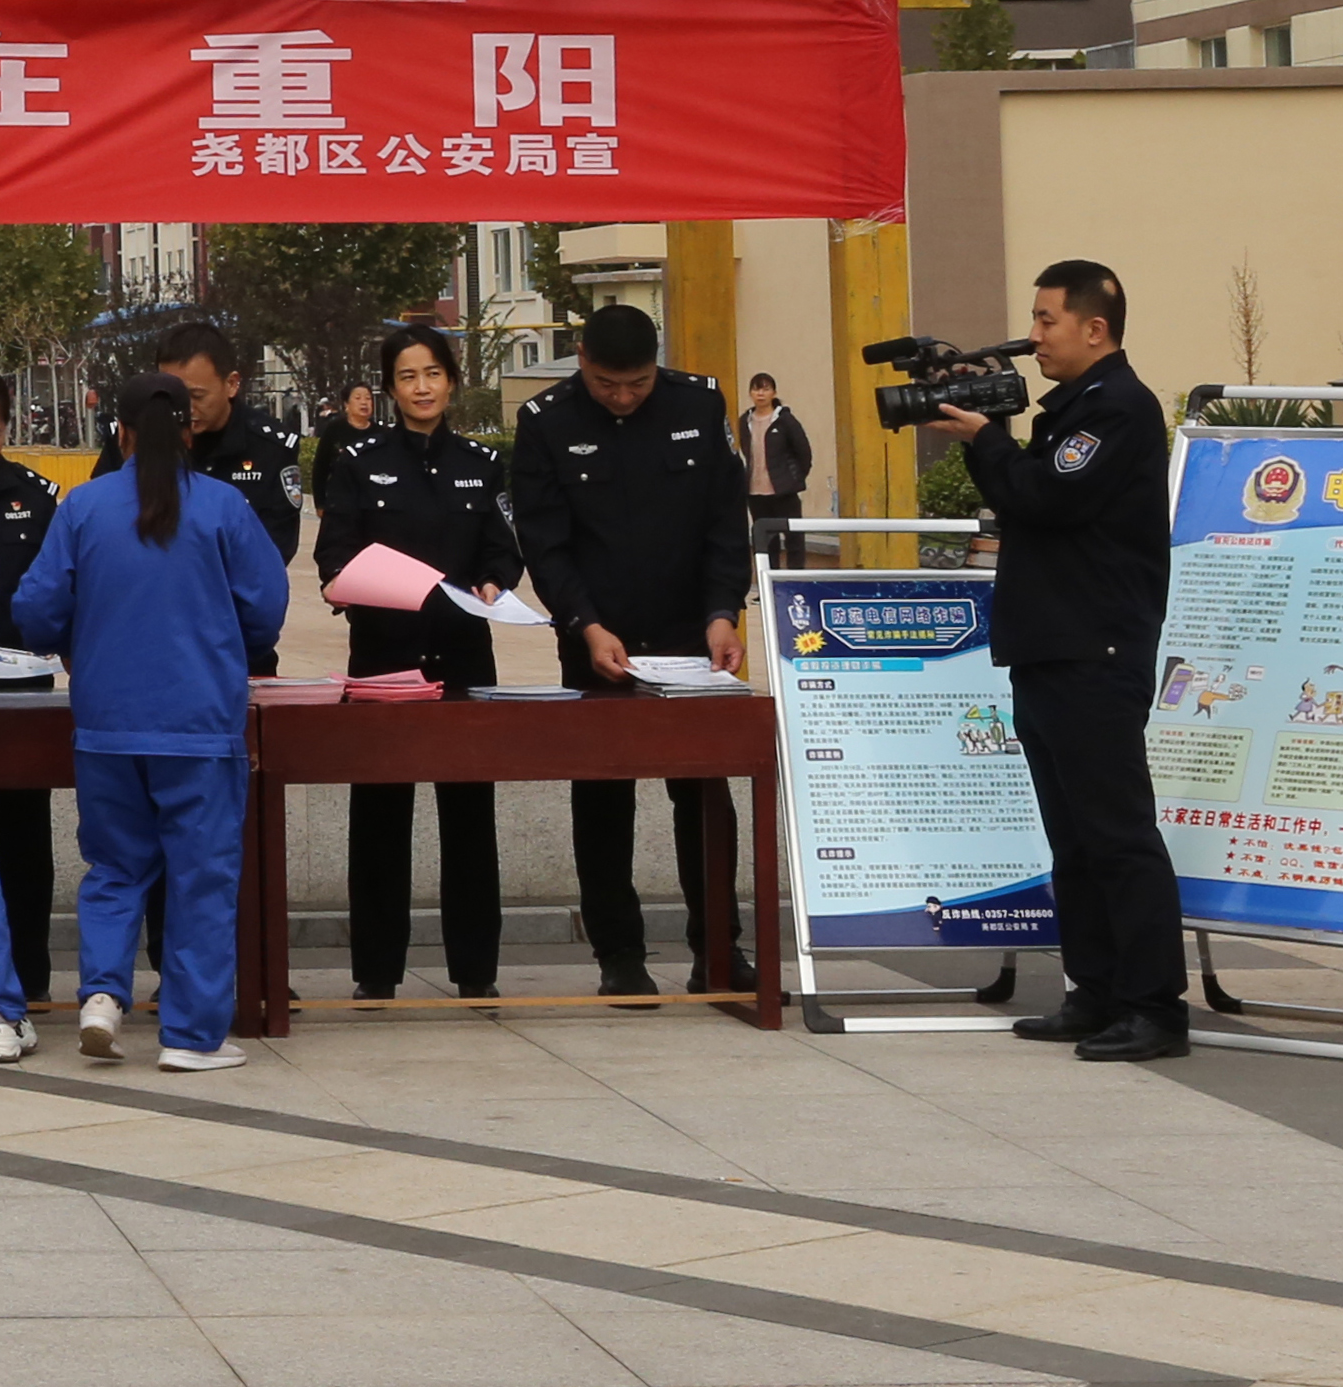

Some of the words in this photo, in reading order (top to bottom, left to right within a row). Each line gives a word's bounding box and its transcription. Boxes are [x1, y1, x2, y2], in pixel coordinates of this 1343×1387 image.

[190, 132, 621, 178] 尧都区公安局宣
[830, 606, 967, 625] 防范电信网络诈骗
